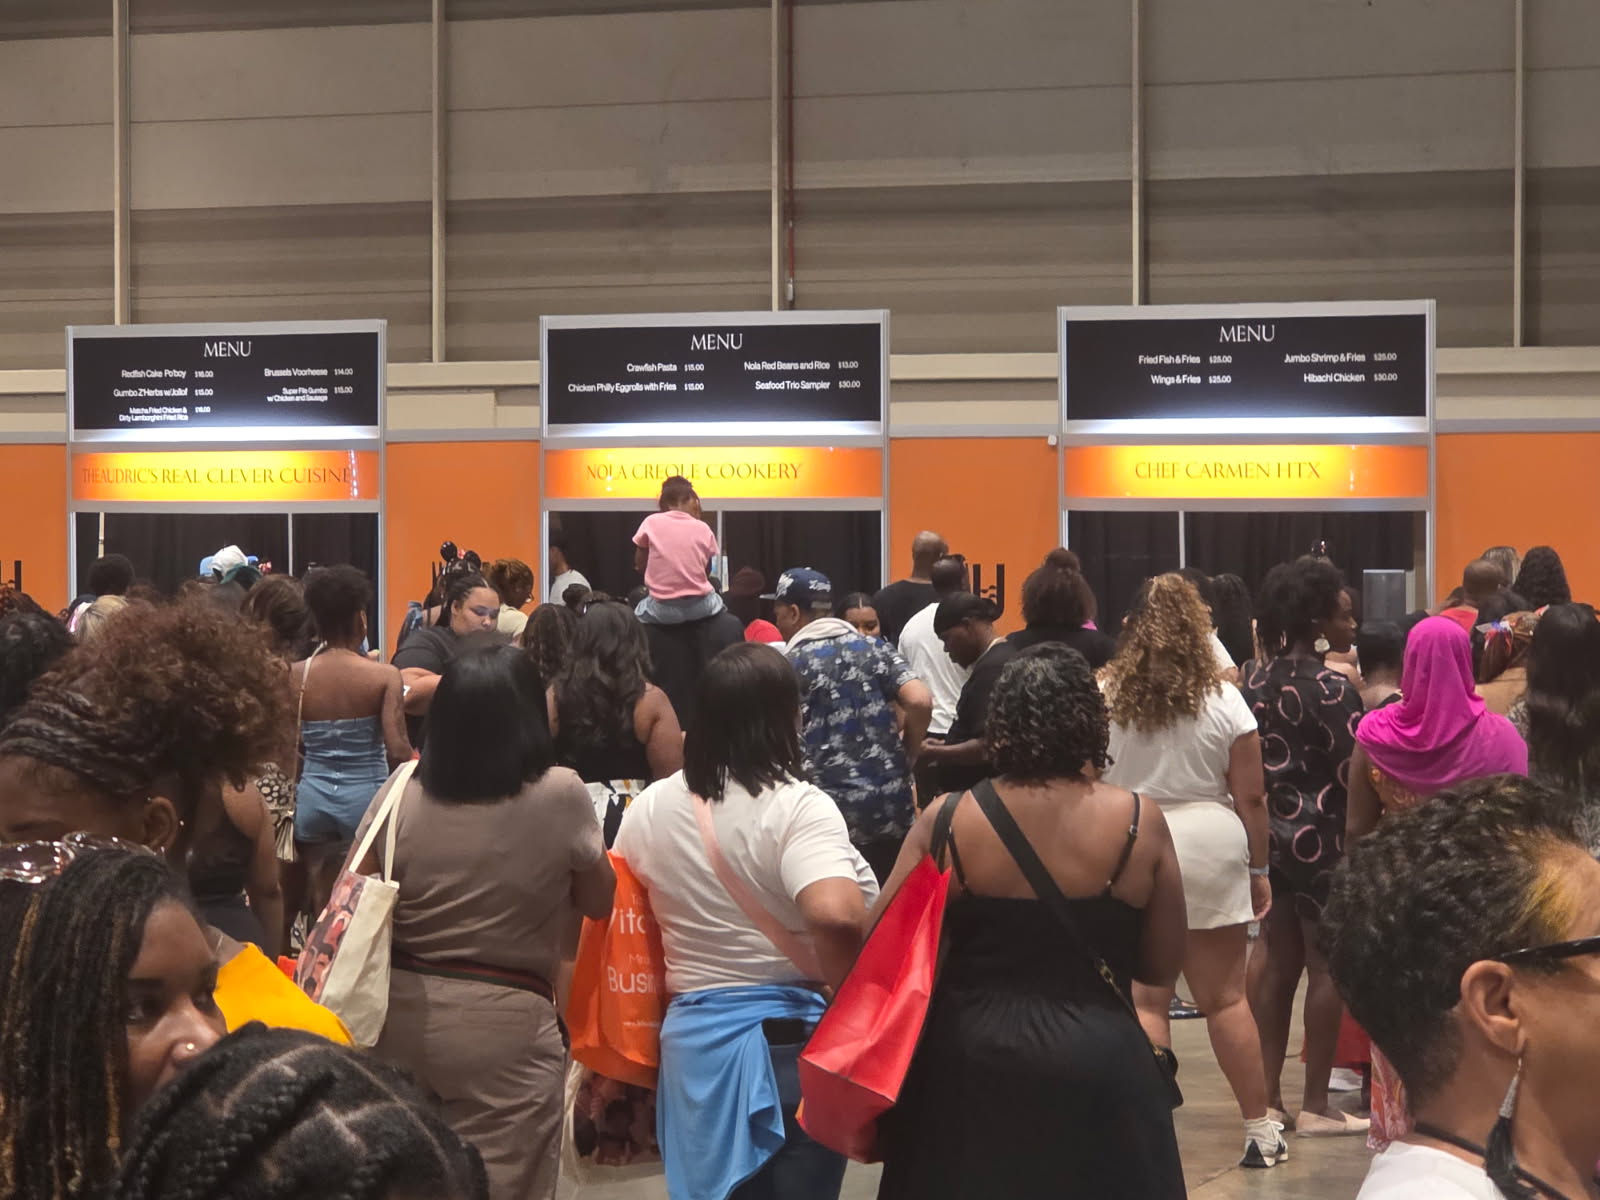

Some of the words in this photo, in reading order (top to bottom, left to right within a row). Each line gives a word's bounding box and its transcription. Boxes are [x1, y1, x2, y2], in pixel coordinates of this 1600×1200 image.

[1219, 324, 1276, 343] MENU
[690, 333, 743, 351] MENU
[204, 341, 252, 357] MENU
[1138, 355, 1158, 364] Fried
[1159, 355, 1174, 364] Fish
[1175, 355, 1181, 364] &
[1182, 355, 1200, 364] Fries
[1284, 354, 1310, 363] Jumbo
[1311, 353, 1339, 364] Shrimp
[1340, 353, 1346, 362] &
[1346, 352, 1366, 362] Fries
[627, 363, 657, 372] Crawfish
[657, 363, 677, 372] Pasta
[744, 362, 761, 370] Nola
[762, 361, 776, 370] Red
[777, 361, 799, 370] Beans
[800, 361, 813, 370] and
[814, 361, 830, 370] Rice
[122, 369, 146, 378] Redfish
[146, 369, 163, 378] Cake
[264, 368, 292, 376] Brussels
[292, 368, 328, 376] Voorheese
[1150, 374, 1175, 385] Wings
[1176, 374, 1182, 384] &
[1182, 374, 1201, 384] Fries
[1304, 373, 1333, 382] Hibachi
[1334, 373, 1365, 382] Chicken
[568, 384, 596, 392] Chicken
[596, 383, 615, 393] Philly
[615, 383, 643, 393] Eggrolls
[644, 383, 659, 391] with
[659, 383, 677, 391] Fries
[755, 381, 785, 390] Seafood
[786, 381, 800, 389] Trio
[801, 381, 830, 390] Sampler
[113, 388, 138, 397] Gumbo
[162, 468, 200, 484] REAL
[206, 467, 274, 484] CLEVER
[279, 466, 351, 484] CUISINE
[586, 463, 627, 480] NOLA
[632, 463, 701, 480] CREOLE
[706, 463, 803, 480] COOKERY
[1135, 462, 1180, 479] CHEF
[1185, 462, 1270, 479] CARMEN
[1277, 462, 1321, 479] HTX
